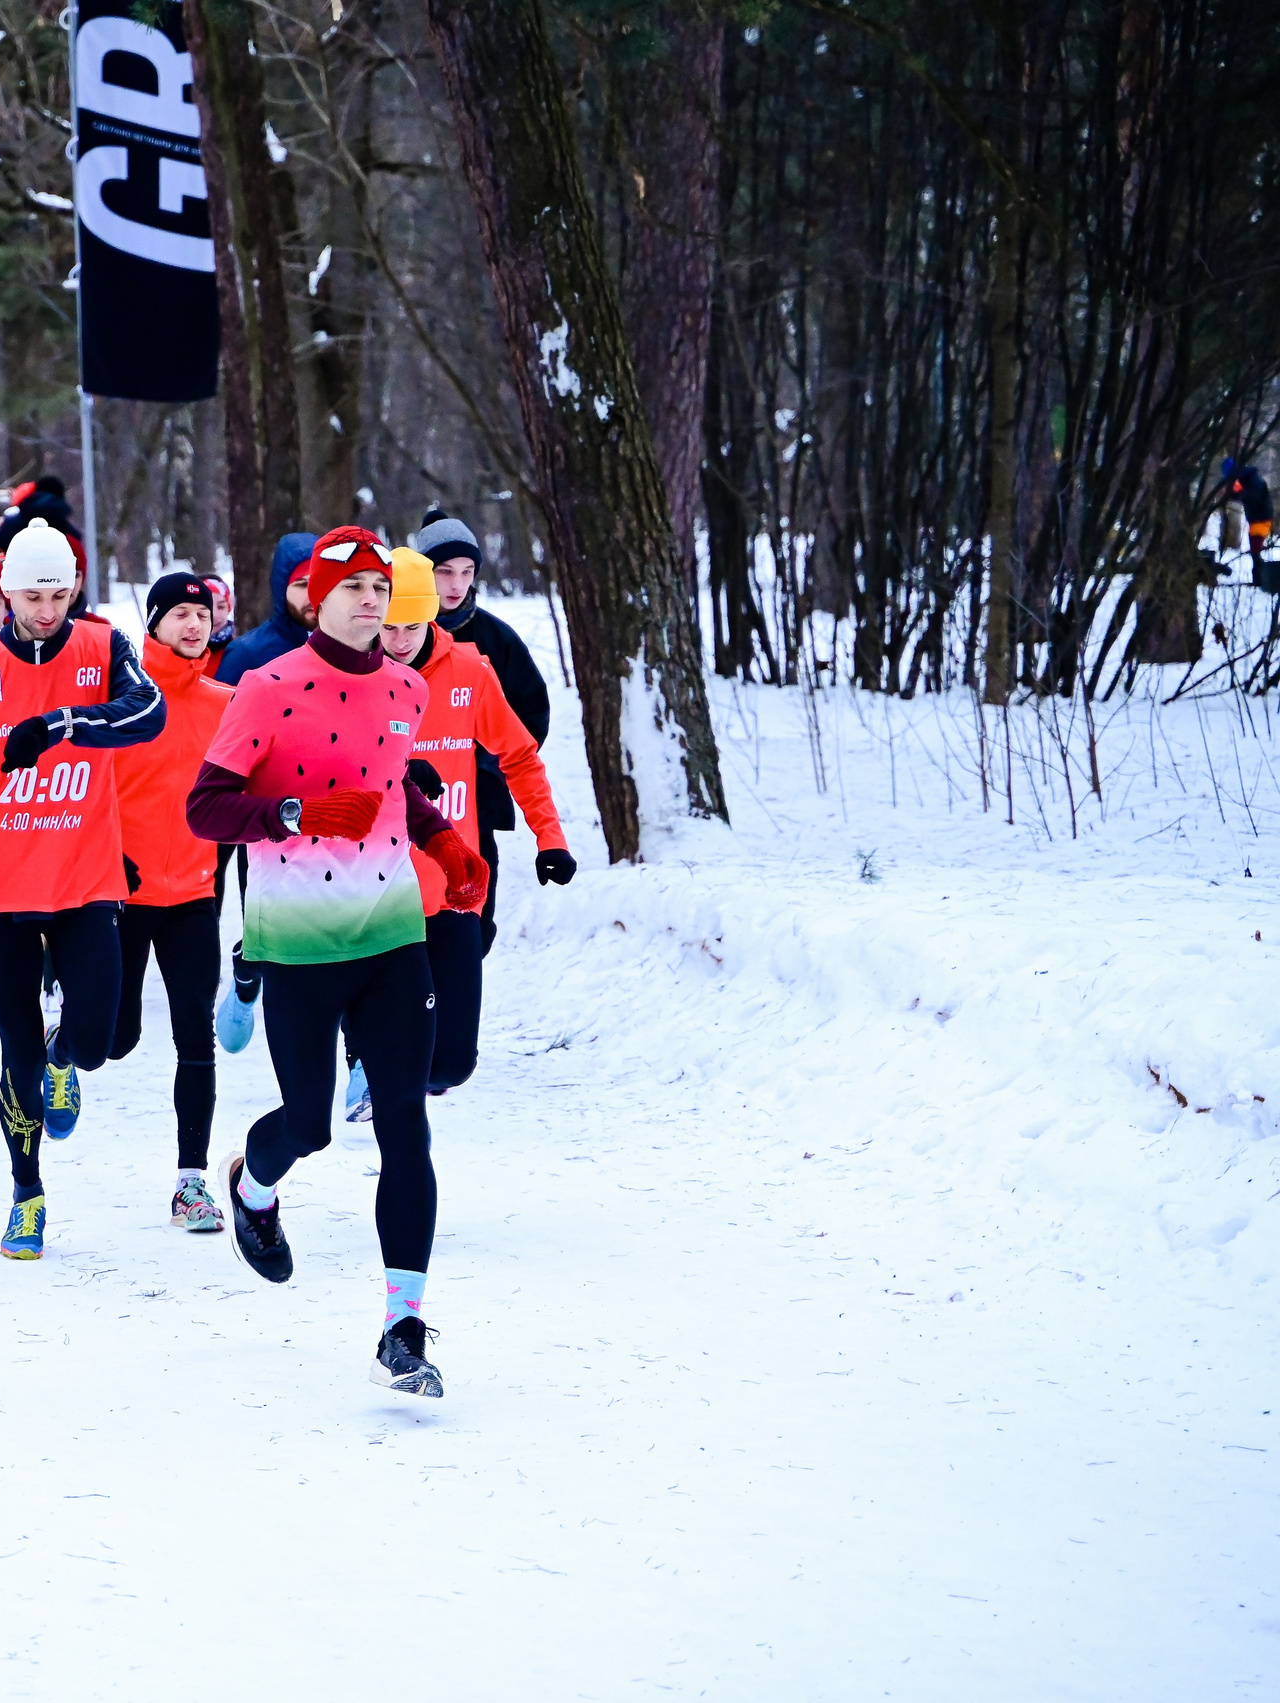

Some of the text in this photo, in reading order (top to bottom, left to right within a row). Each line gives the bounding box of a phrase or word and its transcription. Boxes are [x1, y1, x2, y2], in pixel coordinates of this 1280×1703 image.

[76, 666, 102, 687] GRi
[411, 736, 473, 752] мних Маяков
[0, 810, 82, 830] 4:00 мин/км
